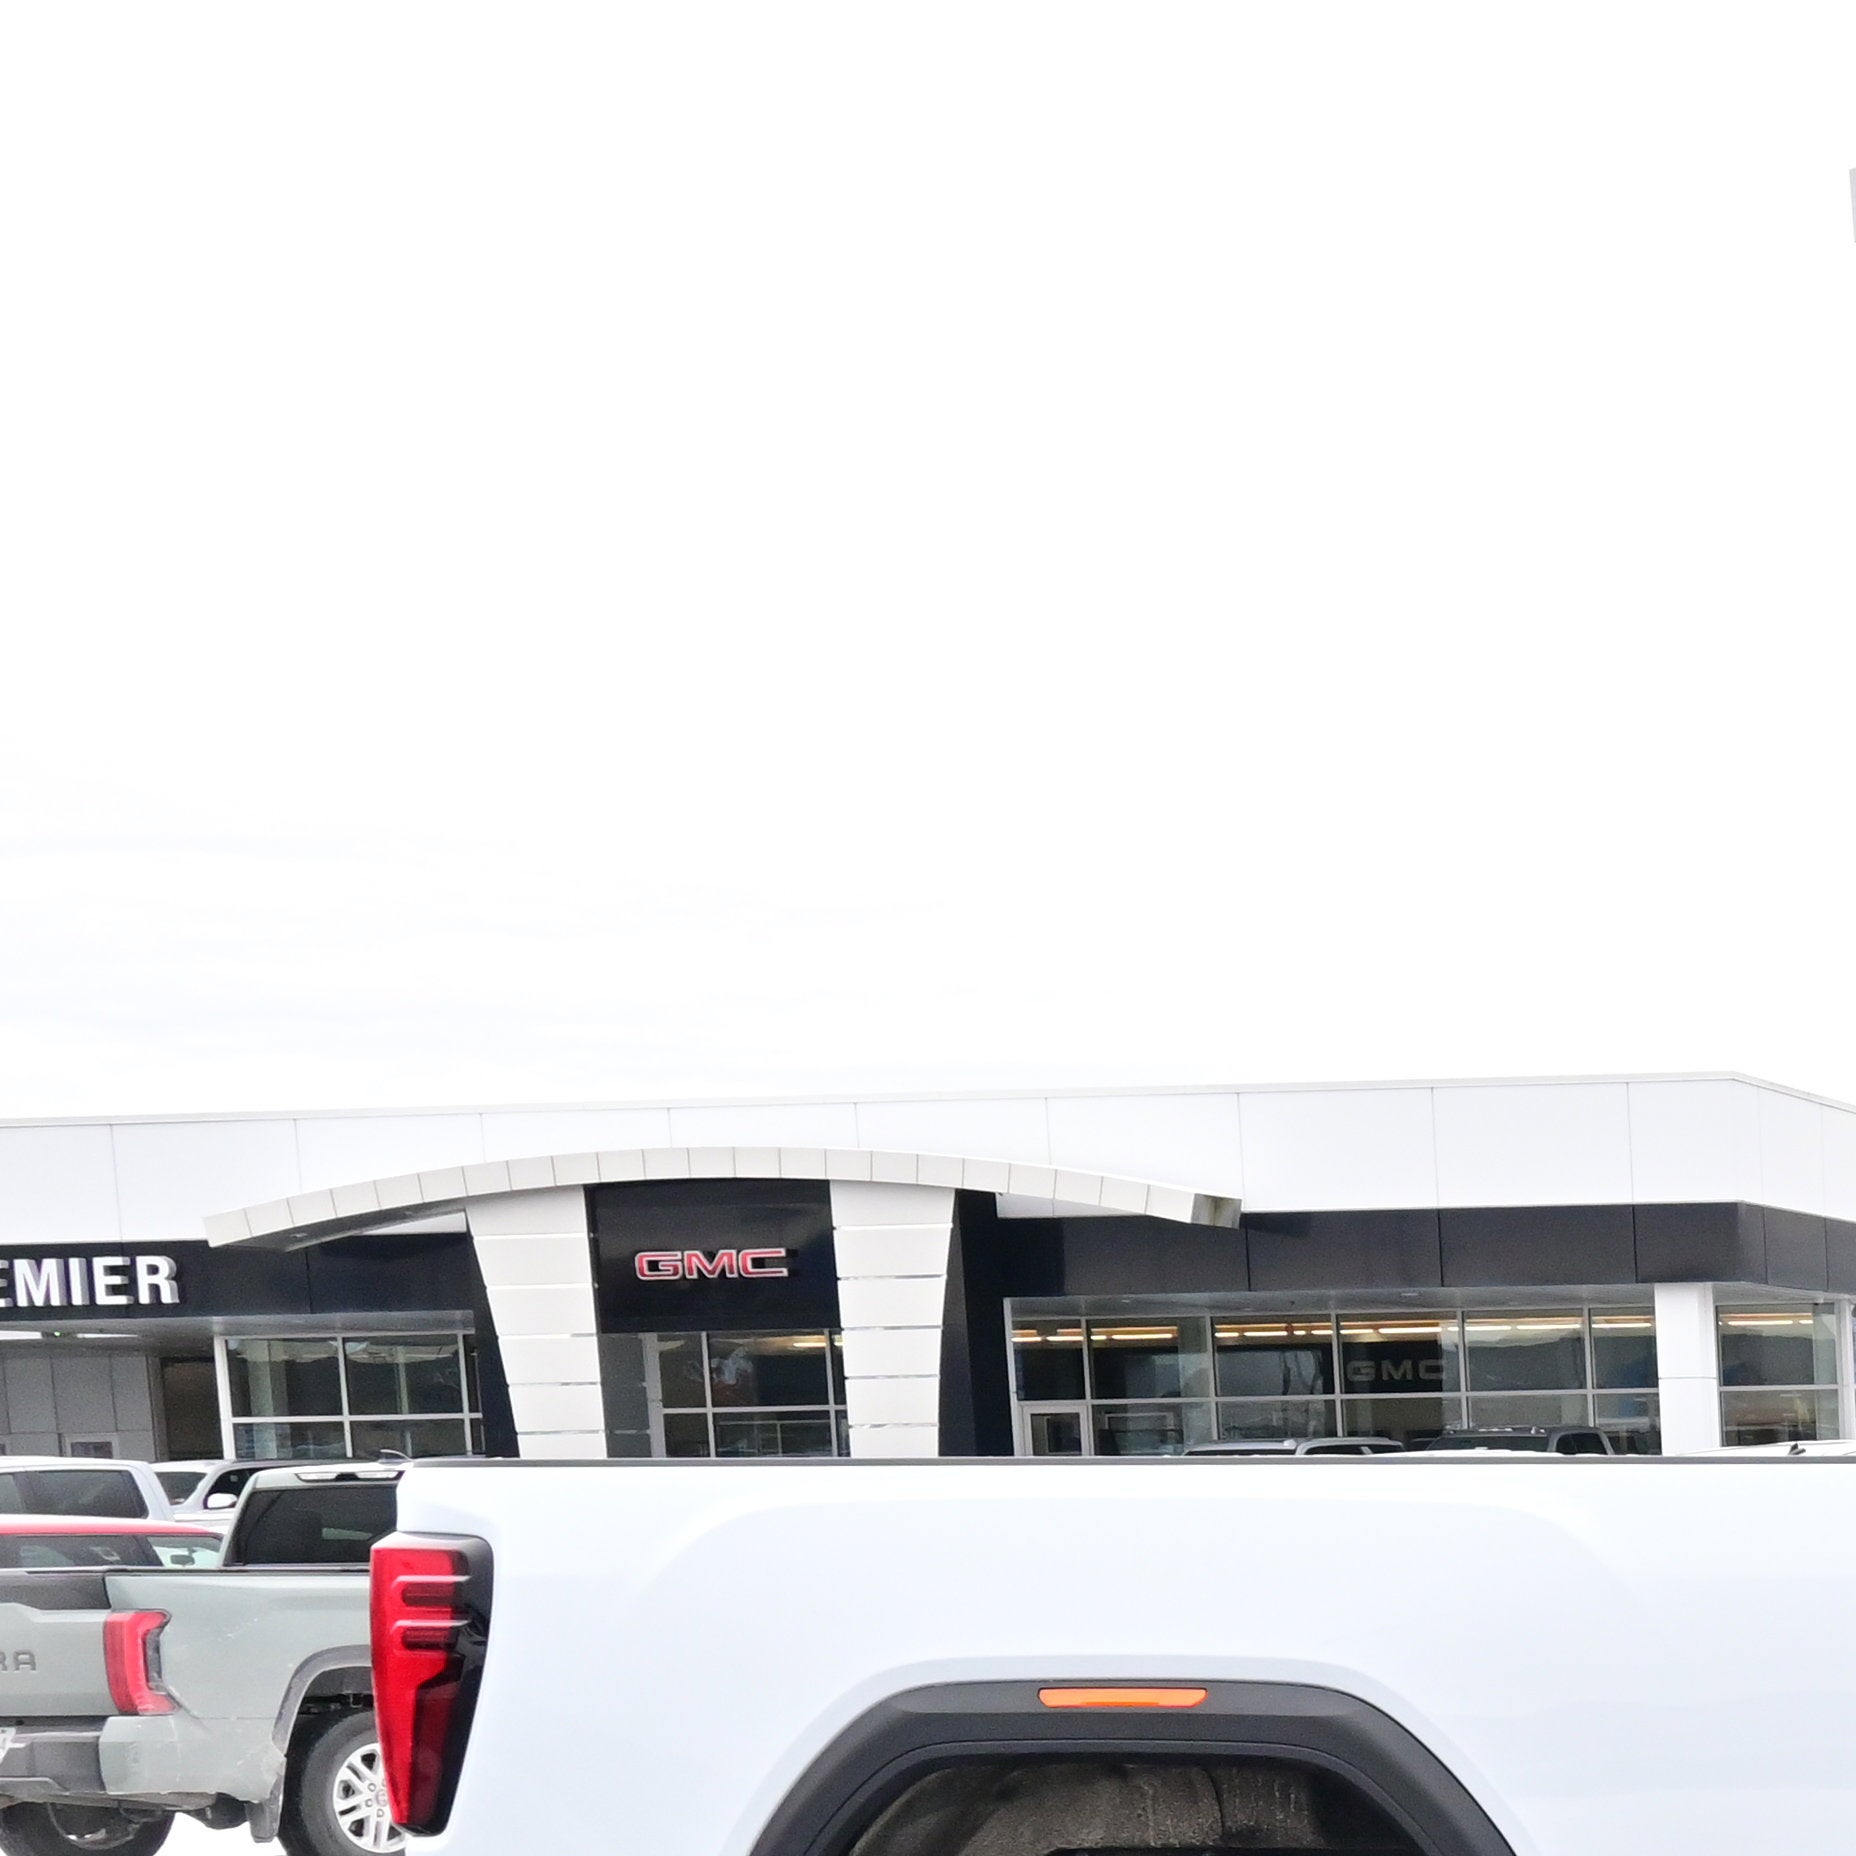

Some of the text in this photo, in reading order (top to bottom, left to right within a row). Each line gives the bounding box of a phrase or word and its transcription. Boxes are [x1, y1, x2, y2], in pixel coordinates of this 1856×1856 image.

[0, 1254, 181, 1308] MIER
[634, 1247, 789, 1281] GMC
[1346, 1359, 1444, 1382] GMC
